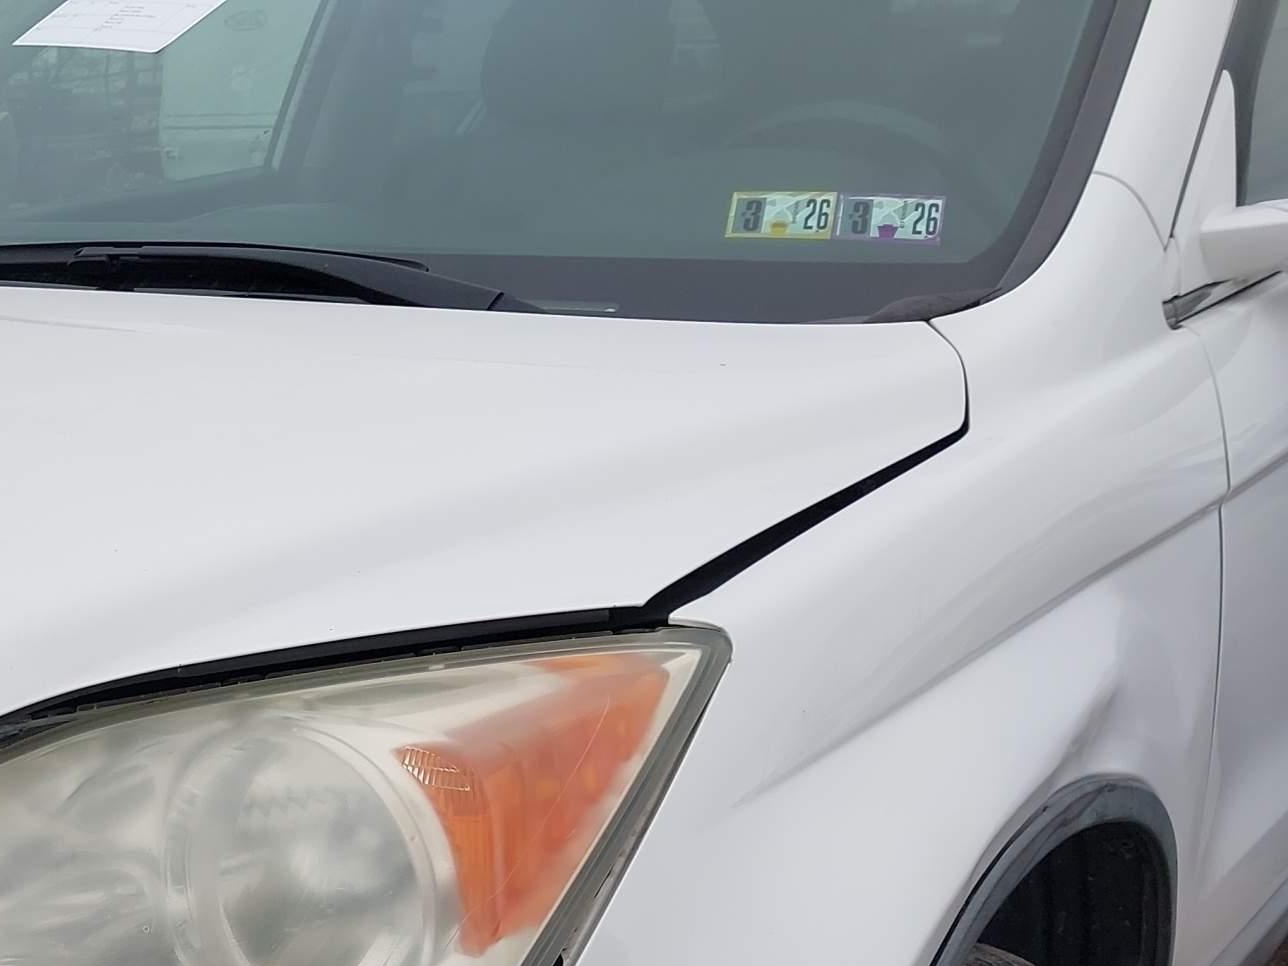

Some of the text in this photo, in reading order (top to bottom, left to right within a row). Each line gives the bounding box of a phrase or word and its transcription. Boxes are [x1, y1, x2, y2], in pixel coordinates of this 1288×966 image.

[743, 199, 762, 232] 3
[803, 198, 831, 230] 26
[850, 201, 869, 235] 3
[911, 202, 940, 236] 26
